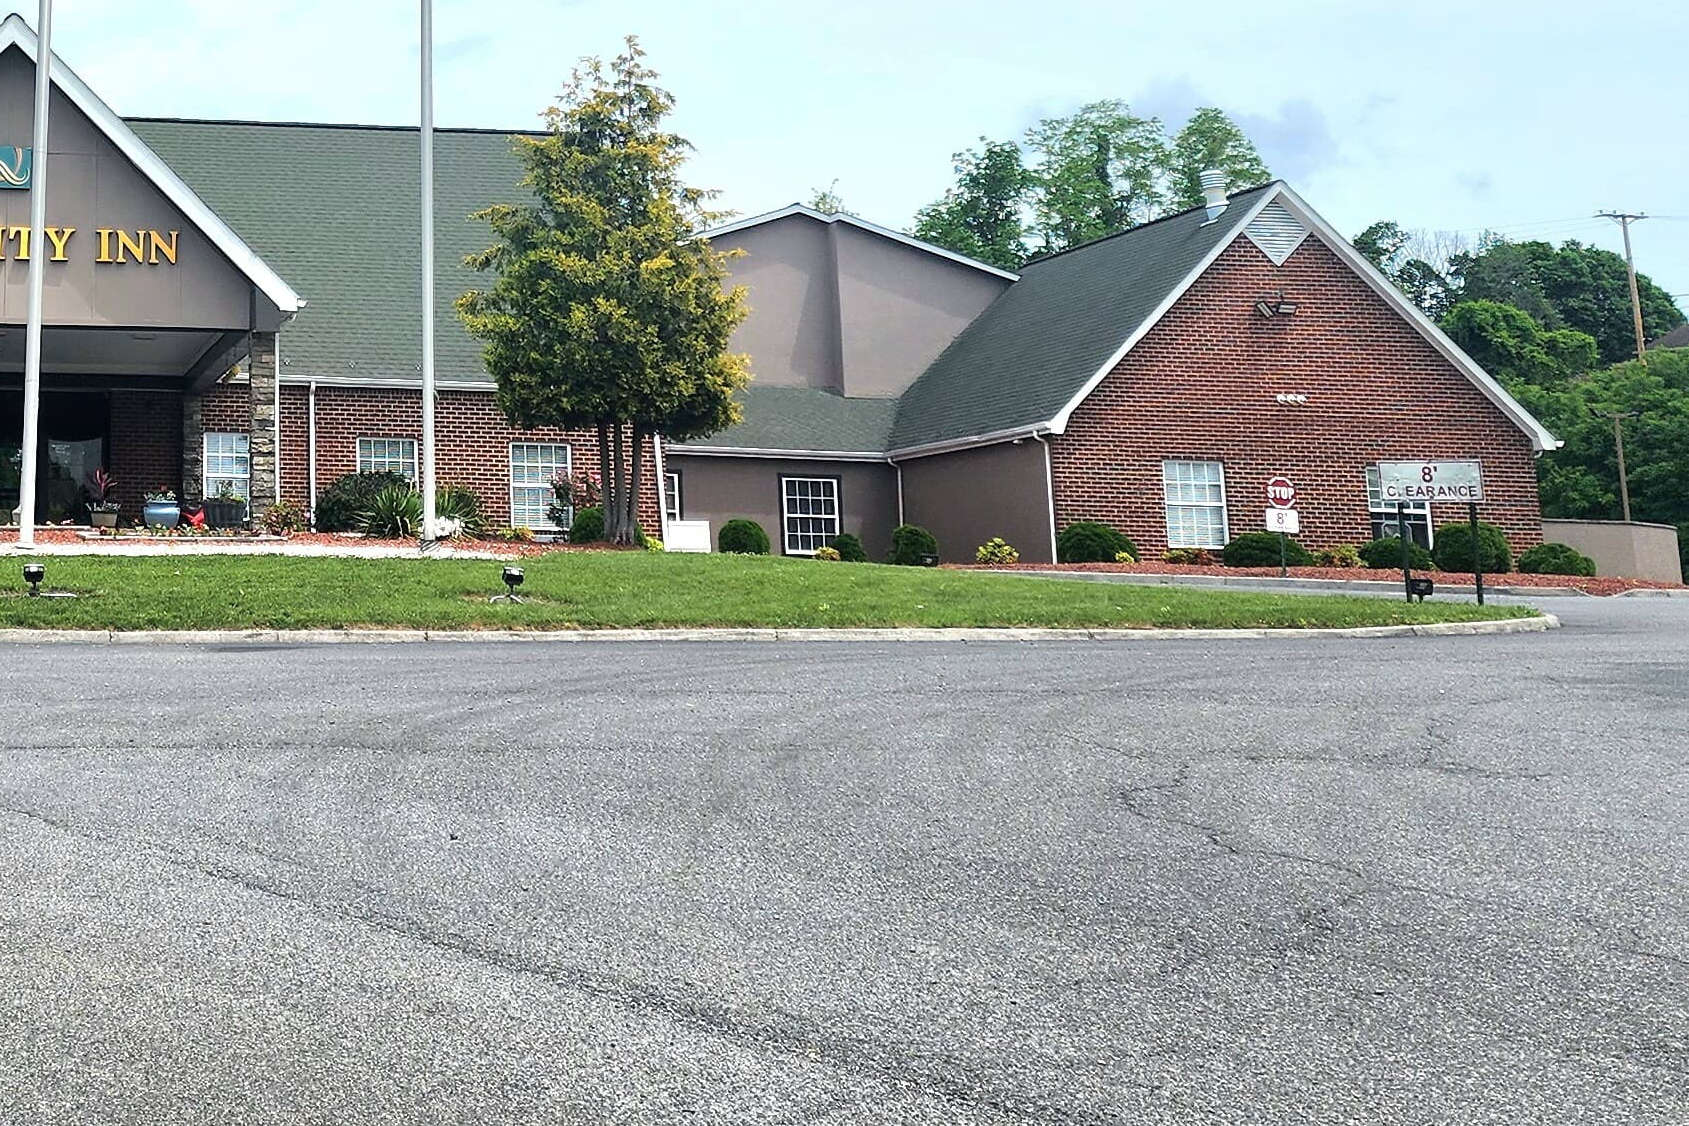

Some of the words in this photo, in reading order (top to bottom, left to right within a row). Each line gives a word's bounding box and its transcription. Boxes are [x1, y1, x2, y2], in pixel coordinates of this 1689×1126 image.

[95, 227, 179, 265] INN
[1421, 466, 1438, 483] 8'
[1267, 486, 1295, 500] STOP
[1387, 485, 1477, 498] CEARANCE
